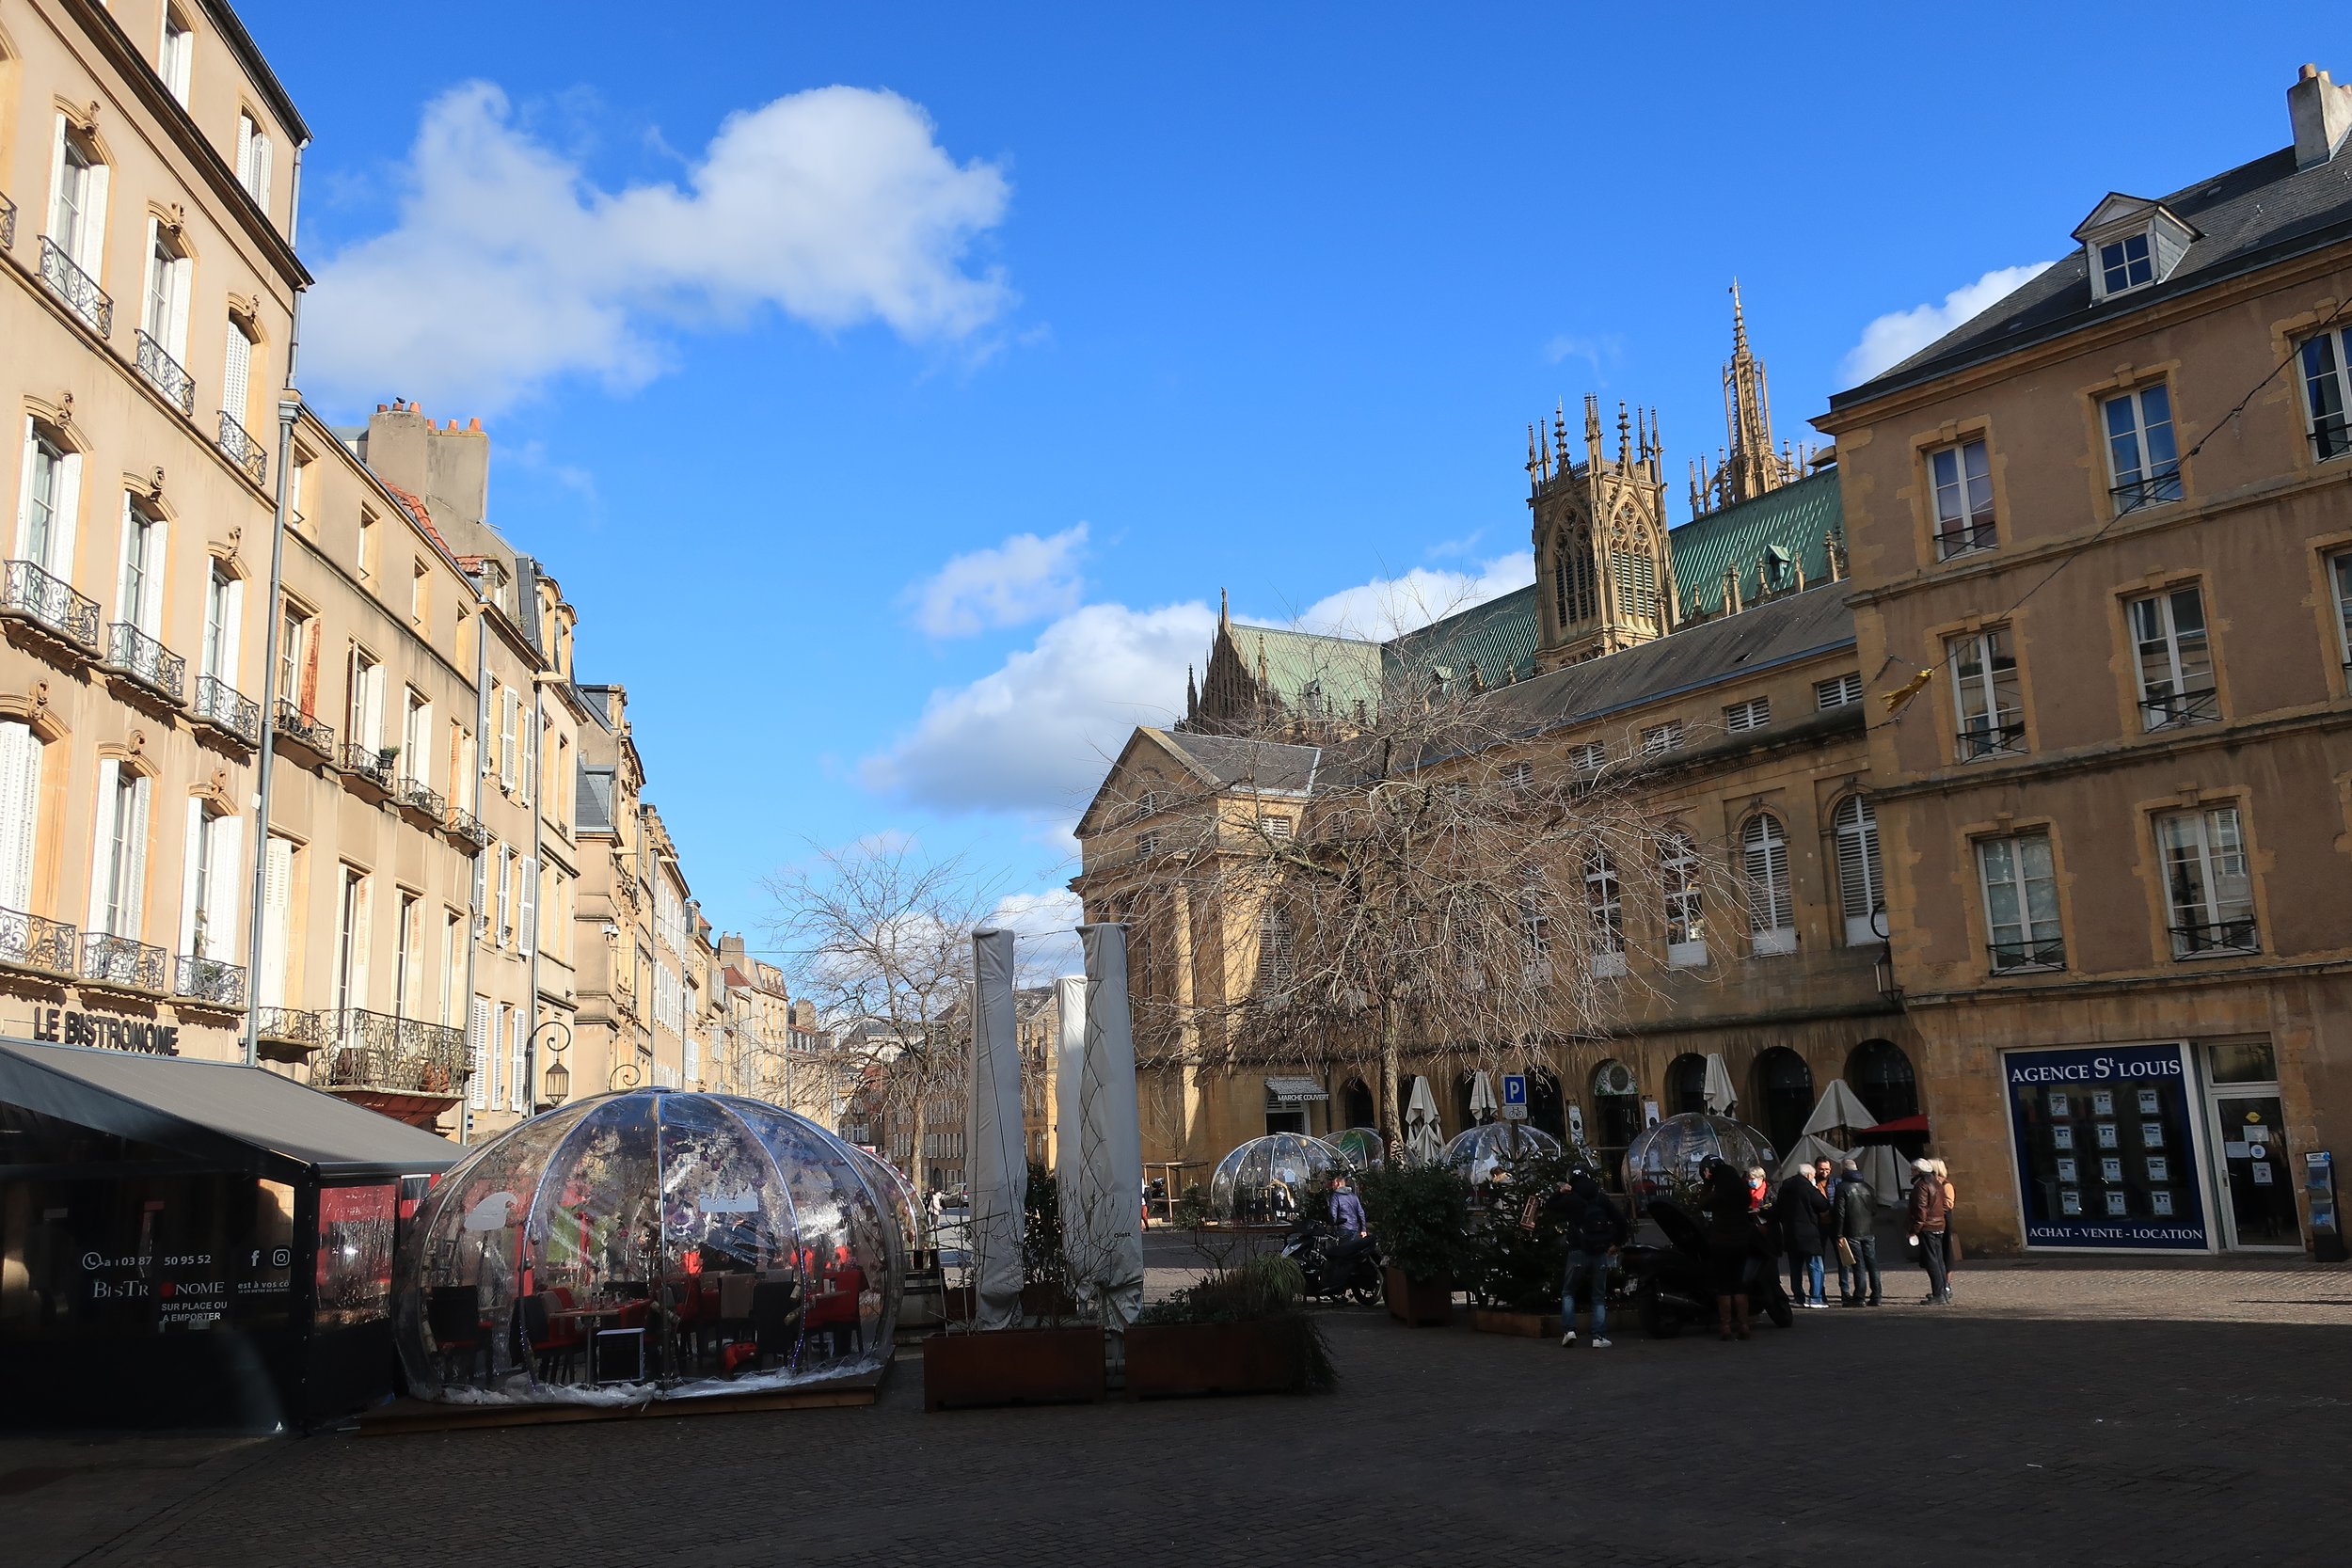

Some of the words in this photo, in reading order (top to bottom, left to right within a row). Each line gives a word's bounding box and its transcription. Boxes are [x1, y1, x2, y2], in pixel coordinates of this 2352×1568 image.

[34, 1006, 60, 1042] LE
[65, 1010, 179, 1056] BISTRONOME
[2011, 1065, 2090, 1083] AGENCE
[2118, 1060, 2181, 1078] LOUIS
[1509, 1081, 1520, 1100] P
[2029, 1227, 2072, 1238] ACHAT
[2081, 1227, 2123, 1239] VENTE
[2133, 1228, 2203, 1240] LOCATION
[161, 1303, 180, 1311] SUR
[182, 1301, 212, 1310] PLACE
[214, 1301, 228, 1309] OU
[162, 1314, 169, 1323] A
[171, 1312, 221, 1323] EMPORTER
